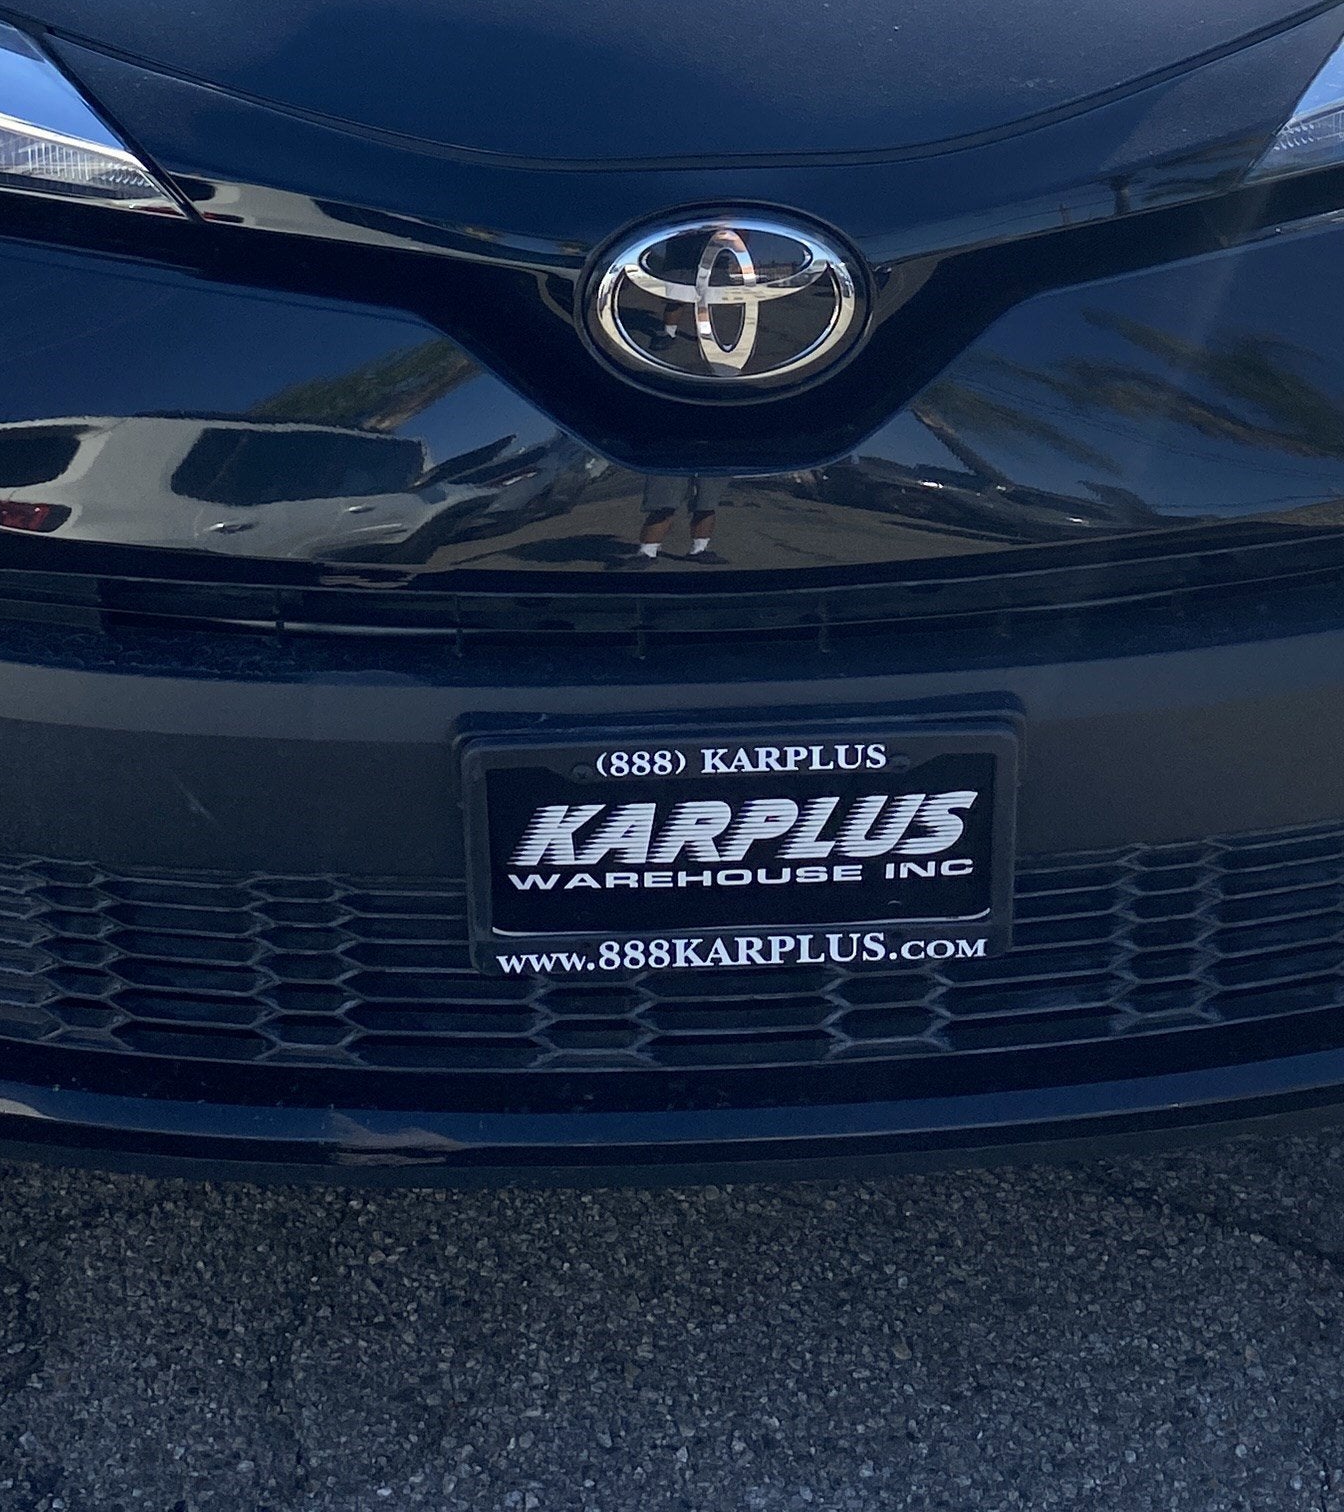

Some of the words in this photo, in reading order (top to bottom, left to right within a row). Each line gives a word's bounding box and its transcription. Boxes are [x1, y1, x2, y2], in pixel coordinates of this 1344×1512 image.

[595, 750, 687, 778] (888)
[701, 744, 887, 774] KARPLUS
[507, 791, 978, 867] KARPLUS
[507, 864, 863, 890] WAREHOUSE
[884, 858, 974, 879] INC
